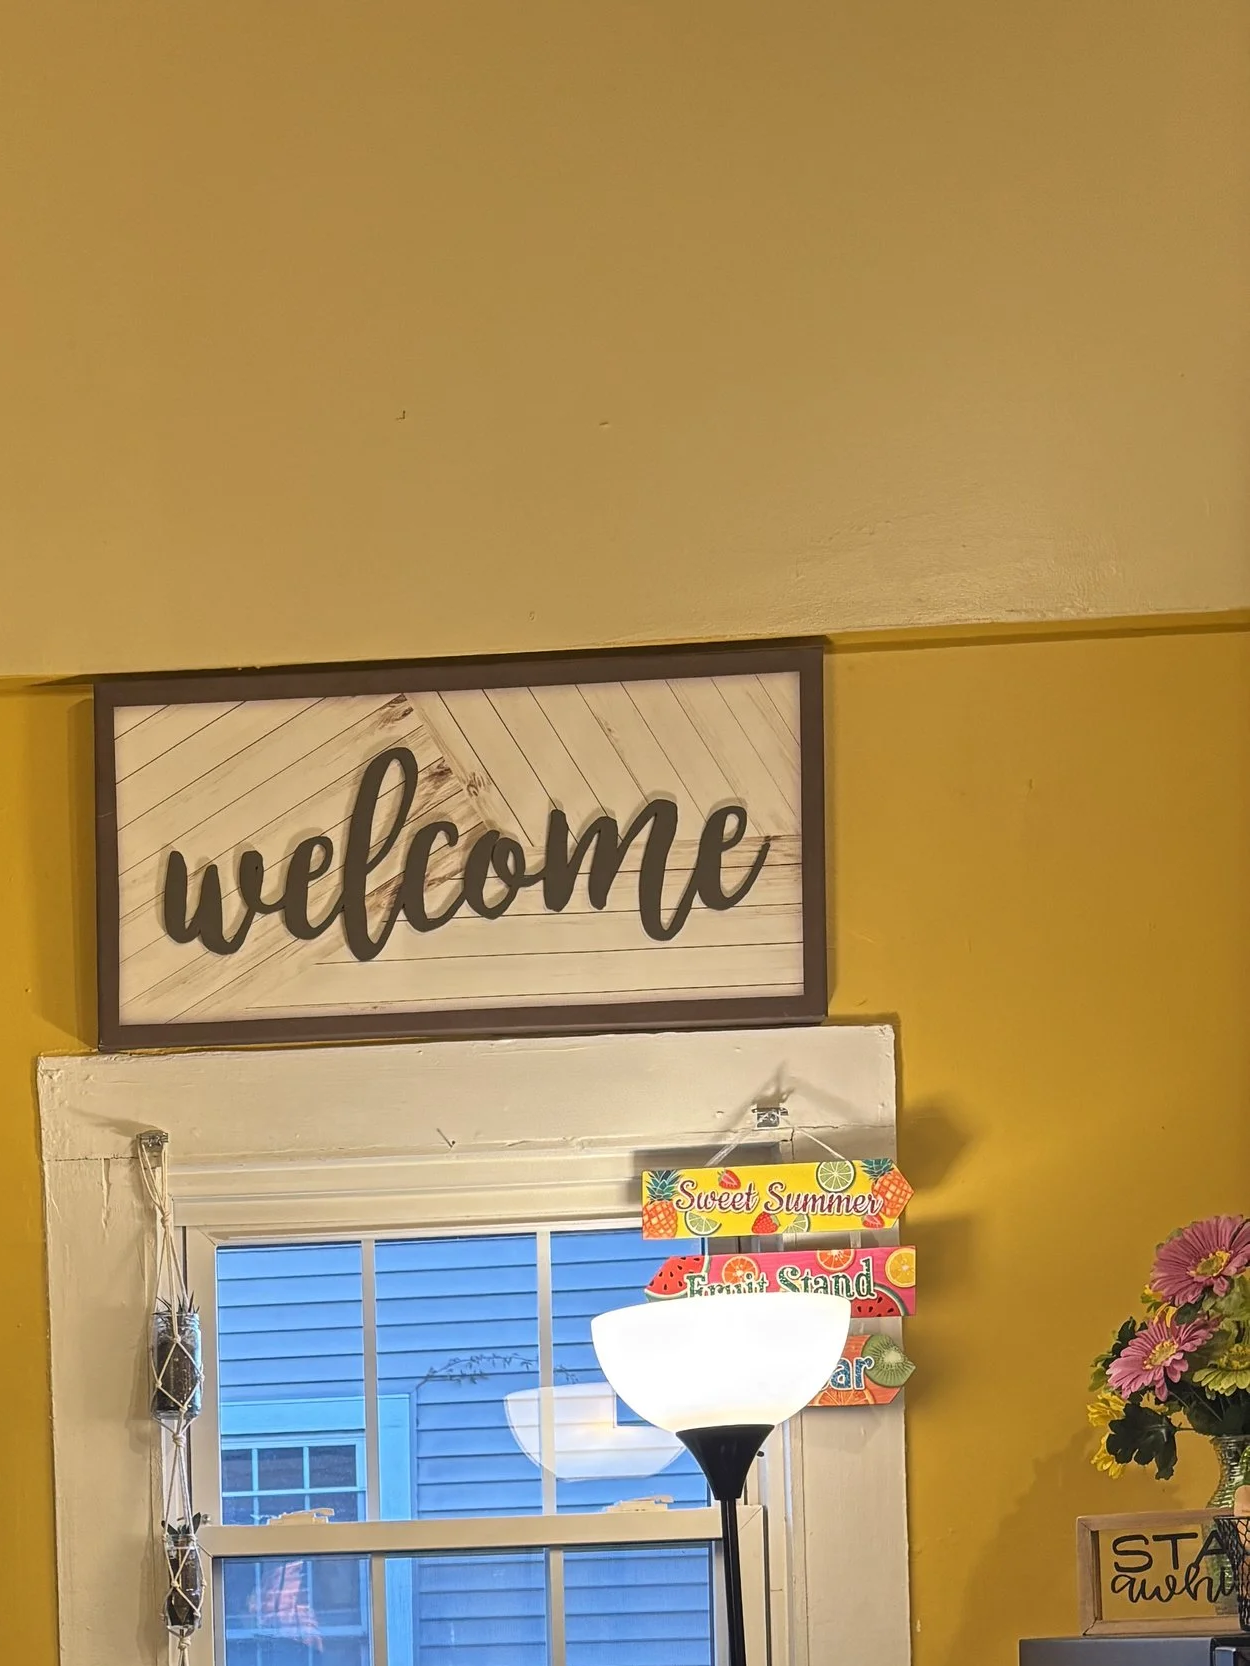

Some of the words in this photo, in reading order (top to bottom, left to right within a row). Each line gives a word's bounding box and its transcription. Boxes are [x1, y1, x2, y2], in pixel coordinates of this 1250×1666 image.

[163, 747, 770, 962] welcome
[675, 1180, 760, 1213] Sweet
[764, 1181, 884, 1215] Summer
[776, 1257, 877, 1299] Stand
[821, 1356, 873, 1391] ar
